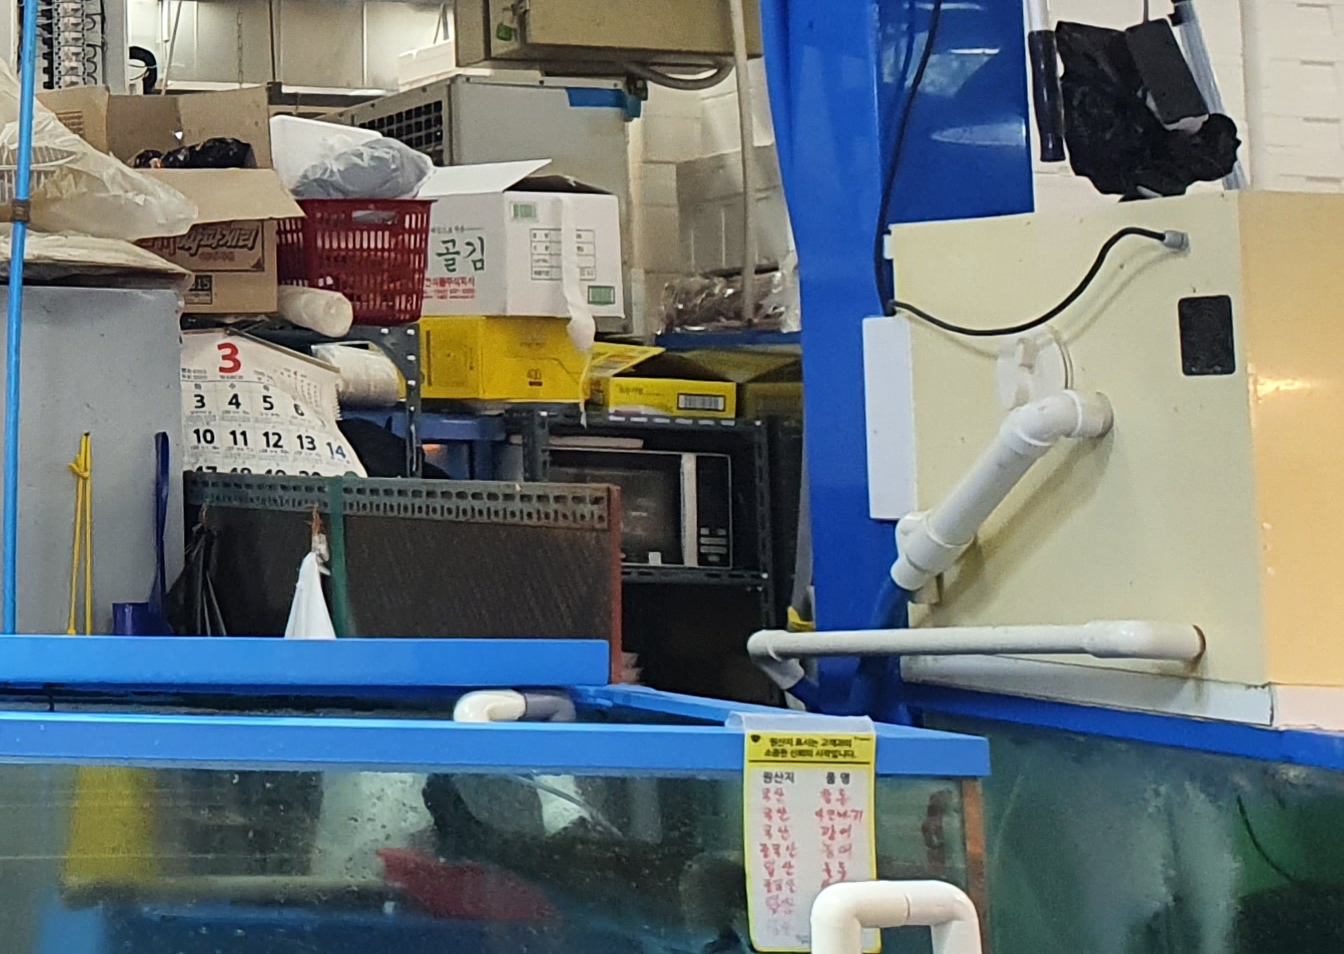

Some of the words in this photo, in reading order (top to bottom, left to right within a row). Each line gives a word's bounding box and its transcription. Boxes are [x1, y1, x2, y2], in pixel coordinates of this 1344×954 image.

[435, 235, 486, 274] 골김
[217, 342, 242, 374] 3
[193, 393, 206, 409] 3
[227, 393, 242, 410] 4
[262, 395, 275, 411] 5
[193, 428, 215, 445] 10
[229, 430, 249, 447] 11
[262, 431, 284, 449] 12
[296, 434, 317, 451] 13
[325, 441, 347, 459] 14
